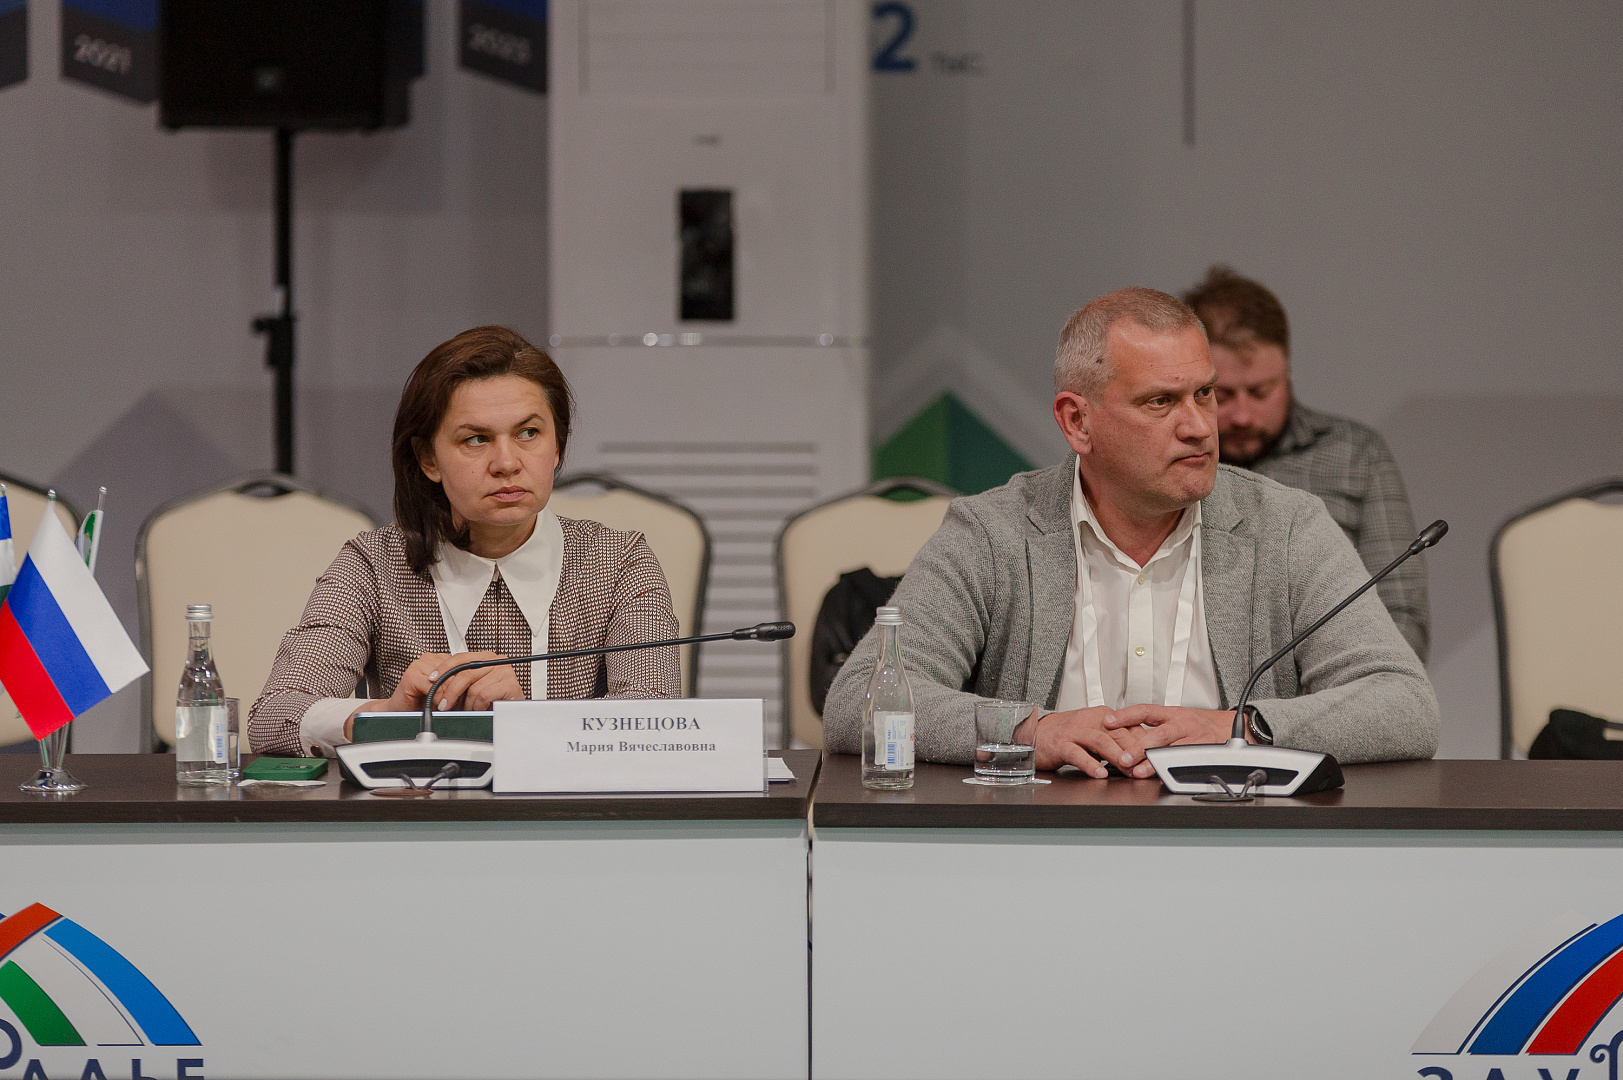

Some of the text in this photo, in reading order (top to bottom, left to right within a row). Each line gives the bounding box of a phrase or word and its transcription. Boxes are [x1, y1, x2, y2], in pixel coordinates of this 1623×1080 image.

[582, 717, 701, 732] КУЗНЕЦОВА
[566, 740, 717, 755] Мария Вячеславовна
